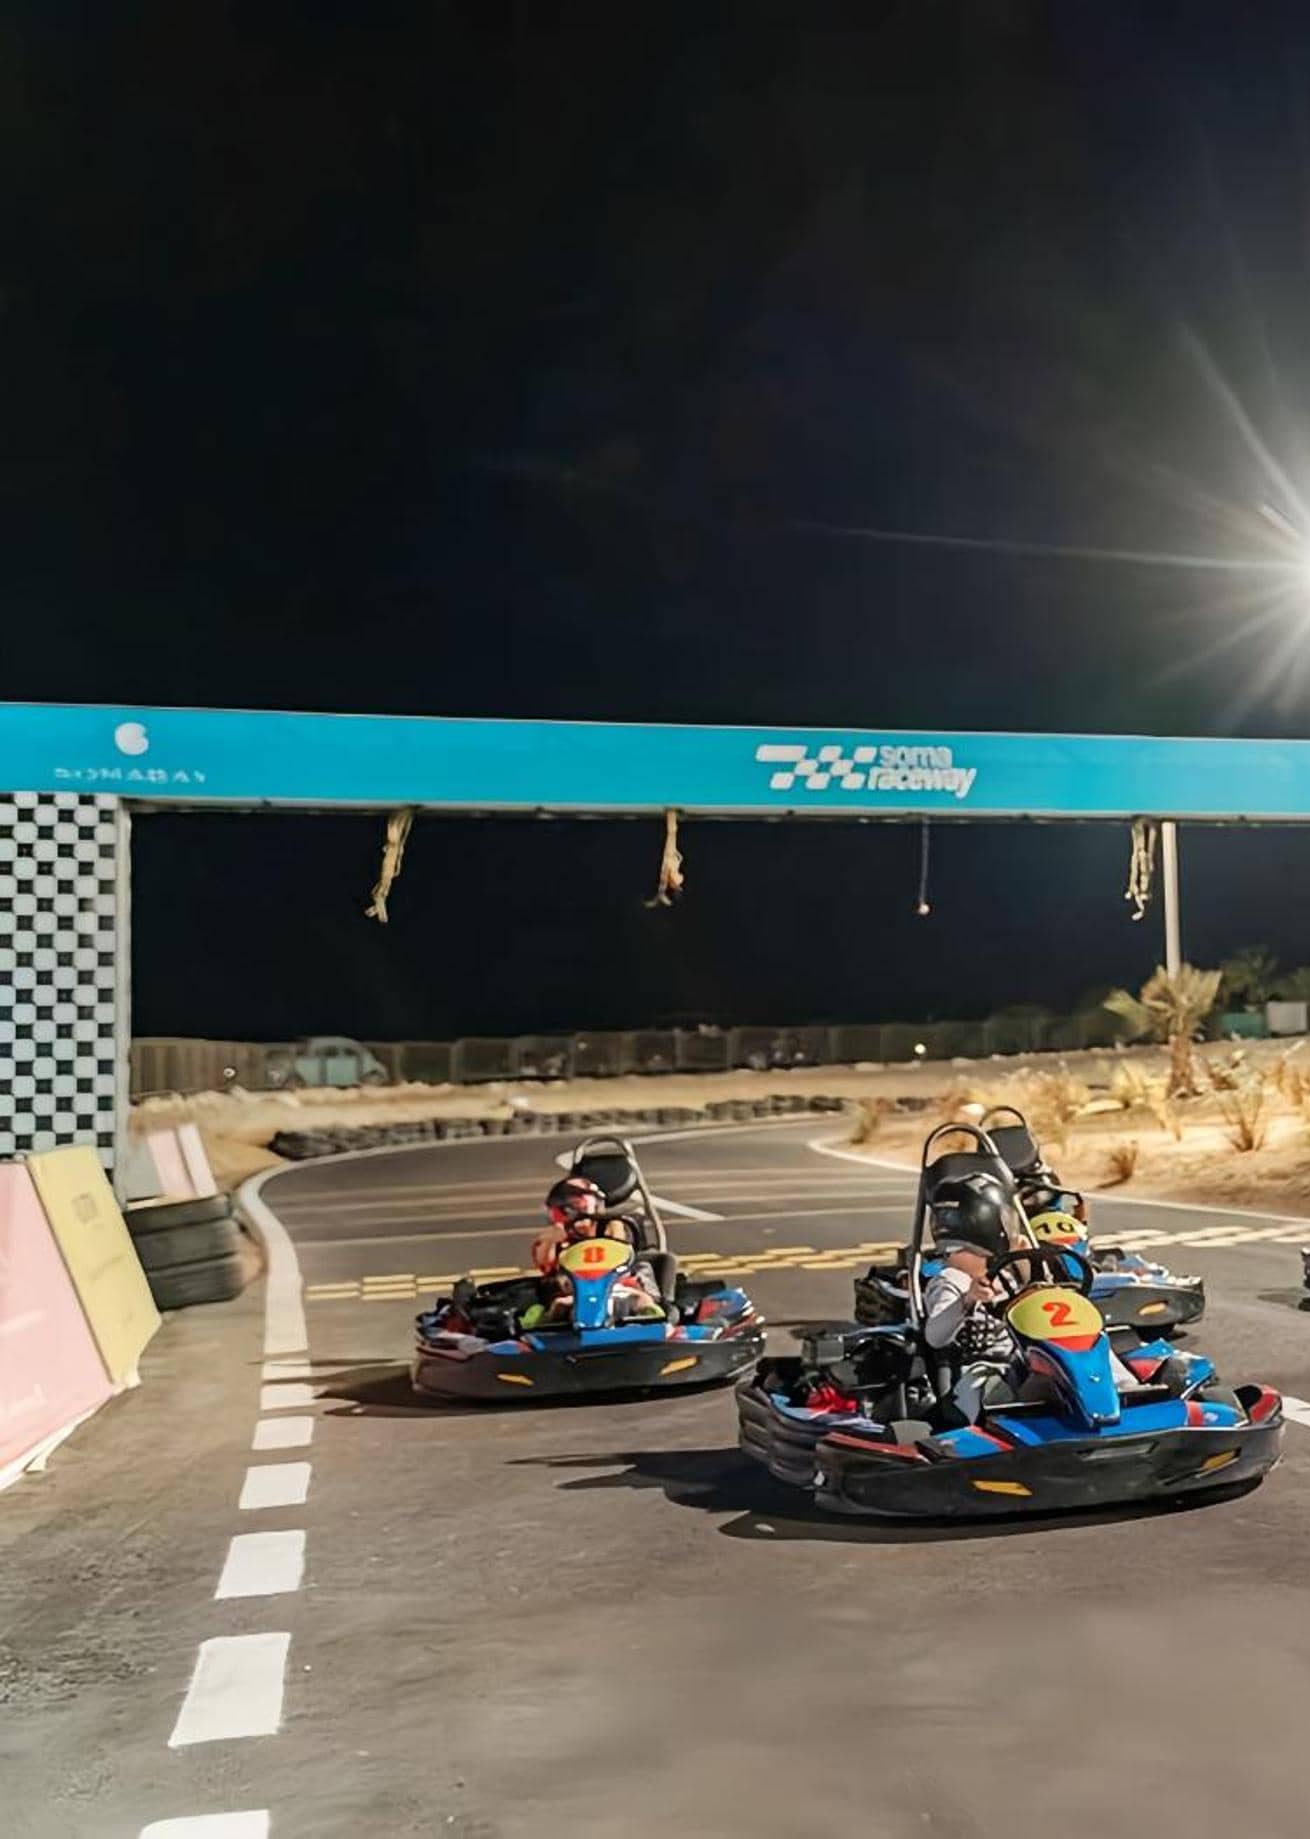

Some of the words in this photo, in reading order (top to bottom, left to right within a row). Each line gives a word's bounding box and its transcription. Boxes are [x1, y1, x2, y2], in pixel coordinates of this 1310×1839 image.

[879, 745, 953, 769] soma
[867, 766, 977, 798] raceway
[1034, 1221, 1076, 1235] 10
[1041, 1302, 1078, 1327] 2
